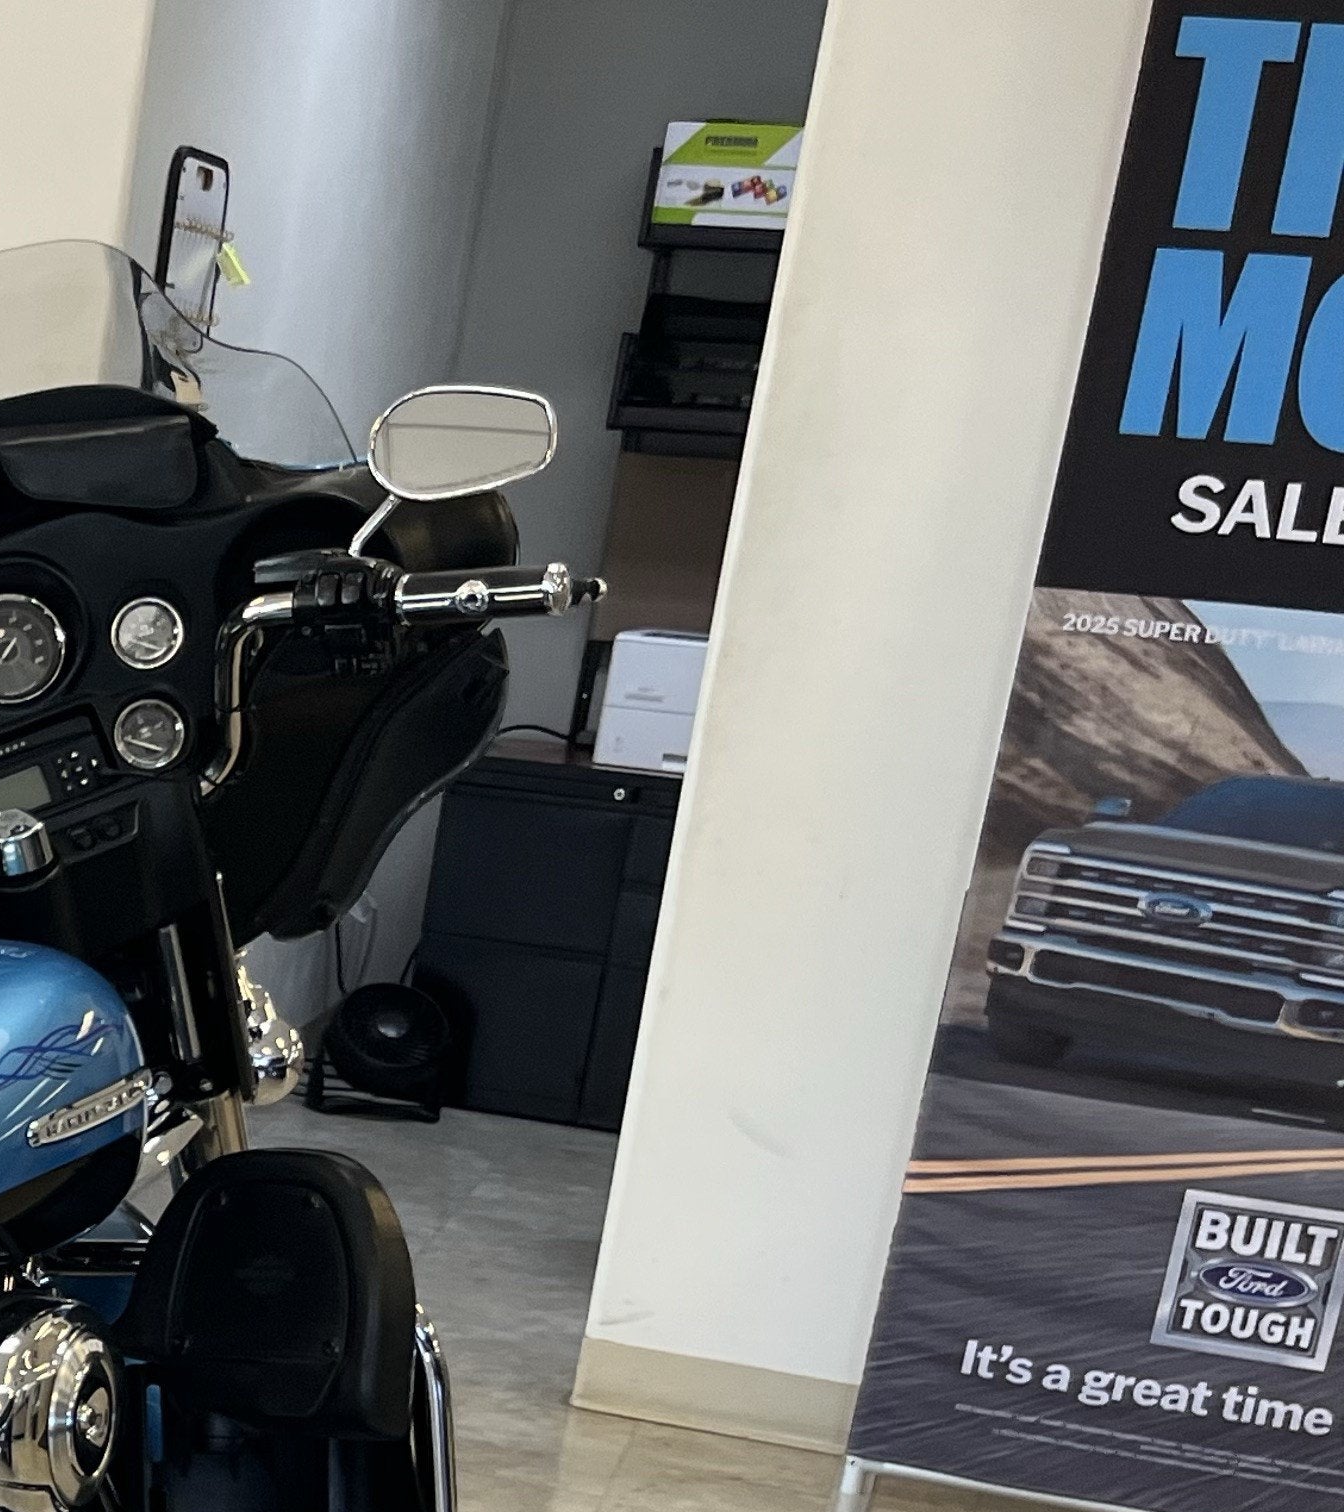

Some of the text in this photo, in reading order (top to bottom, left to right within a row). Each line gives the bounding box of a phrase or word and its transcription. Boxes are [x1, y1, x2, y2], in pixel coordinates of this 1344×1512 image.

[1062, 612, 1120, 636] 2025
[1123, 618, 1204, 644] SUPER
[1195, 1210, 1338, 1267] BUILT
[1217, 1266, 1289, 1299] Ford
[1178, 1298, 1316, 1350] TOUGH
[961, 1339, 1334, 1436] It's a great time
